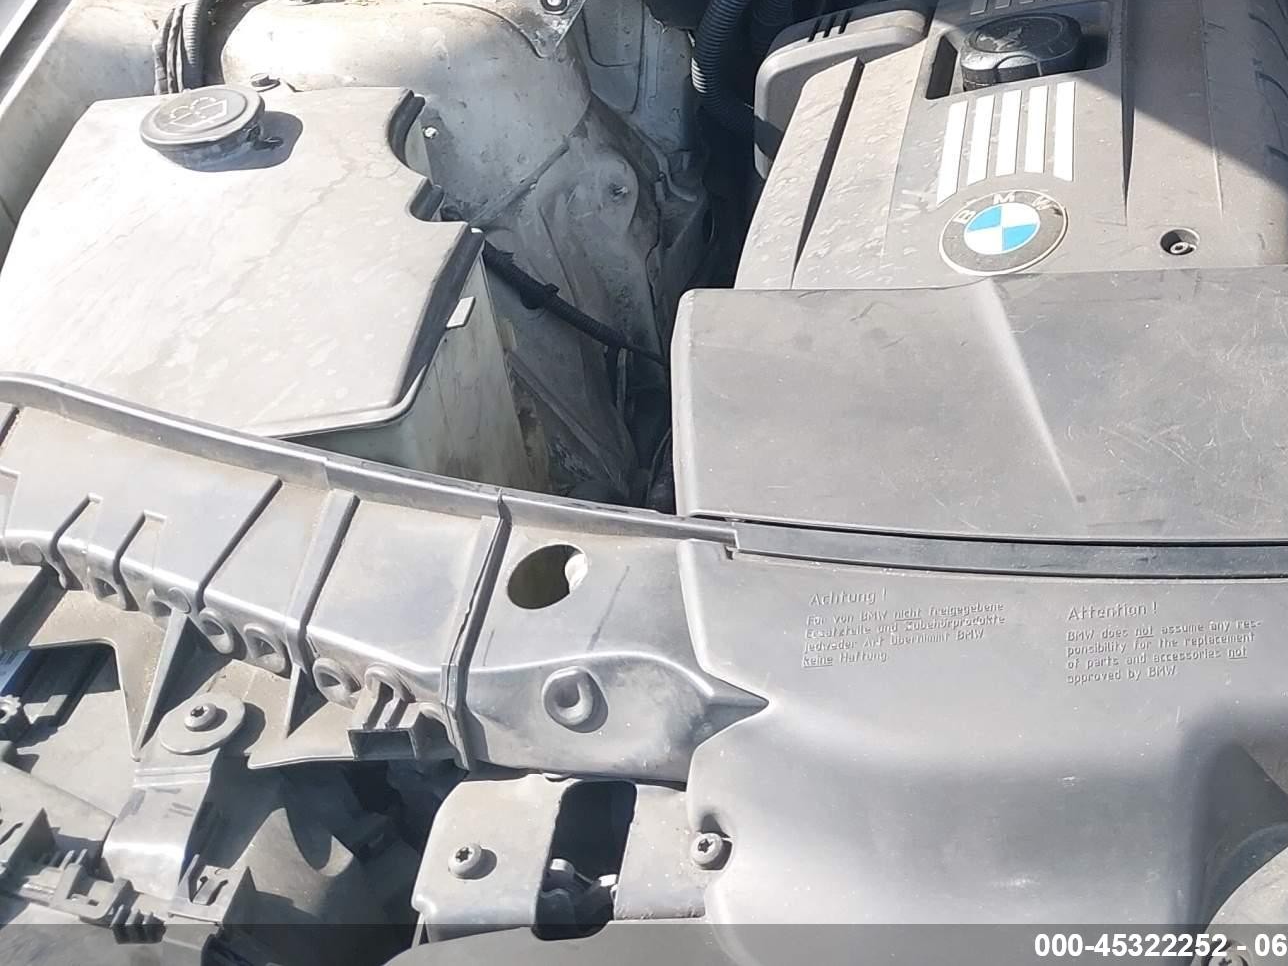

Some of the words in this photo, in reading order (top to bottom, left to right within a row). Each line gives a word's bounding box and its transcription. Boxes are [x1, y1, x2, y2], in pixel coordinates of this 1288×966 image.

[951, 191, 1063, 225] BMW
[809, 591, 876, 606] Achtung
[860, 609, 888, 622] BMW
[894, 608, 922, 620] nicht
[1068, 601, 1147, 621] Attention
[877, 622, 899, 634] und
[1067, 629, 1095, 642] BMW
[1101, 627, 1129, 640] does
[1135, 625, 1154, 637] not
[1160, 623, 1204, 635] assume
[1209, 620, 1231, 633] any
[863, 636, 884, 648] Art
[956, 628, 984, 642] BMW
[1134, 638, 1152, 650] for
[1159, 636, 1178, 649] the
[1184, 633, 1256, 648] replacement
[803, 653, 834, 666] keine
[1067, 657, 1080, 670] of
[1087, 654, 1120, 669] parts
[1126, 652, 1147, 665] and
[1153, 648, 1222, 663] accessories
[1228, 646, 1248, 658] not
[1066, 669, 1121, 685] approved
[1127, 666, 1142, 681] by
